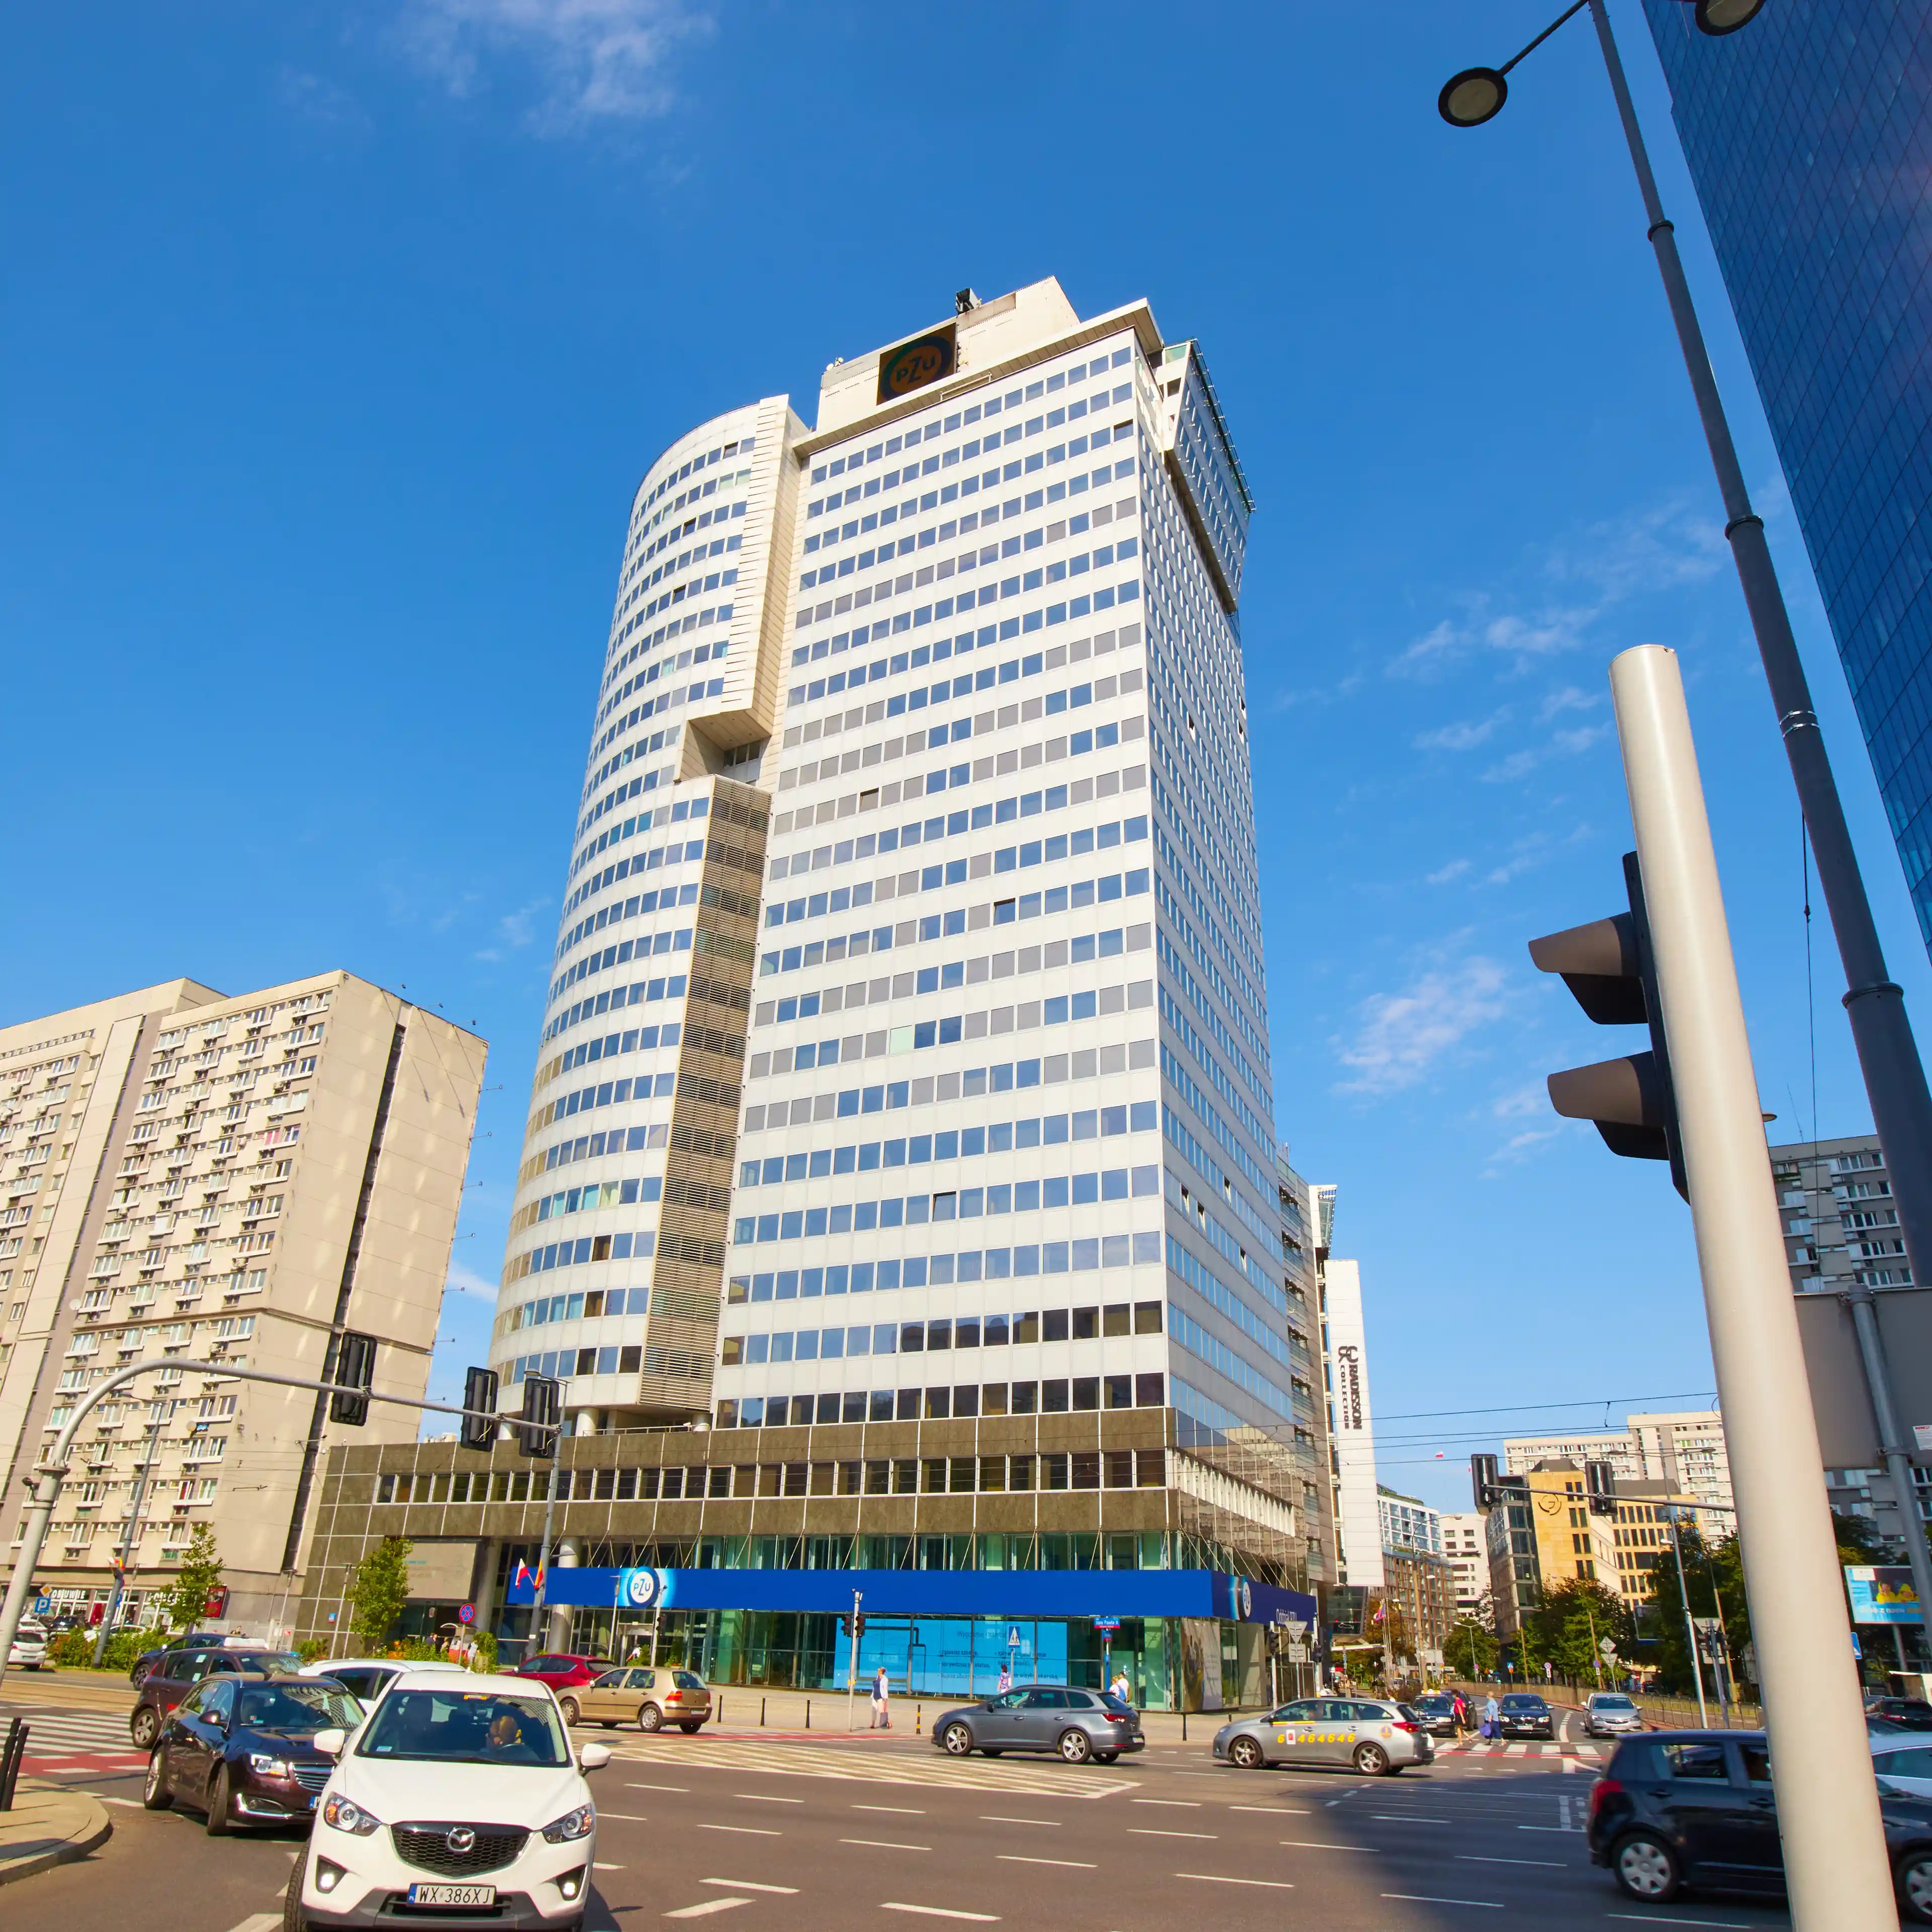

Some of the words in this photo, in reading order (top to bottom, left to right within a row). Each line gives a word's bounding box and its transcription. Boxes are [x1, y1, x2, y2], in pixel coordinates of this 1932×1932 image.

[896, 355, 936, 385] PZU
[1340, 1364, 1349, 1430] COLLECTION
[1349, 1364, 1362, 1430] RADISSON
[51, 1589, 86, 1599] OBUWIE
[633, 1578, 651, 1596] PZU
[37, 1599, 47, 1612] P
[419, 1886, 439, 1902] WX
[444, 1887, 490, 1904] 386XJ
